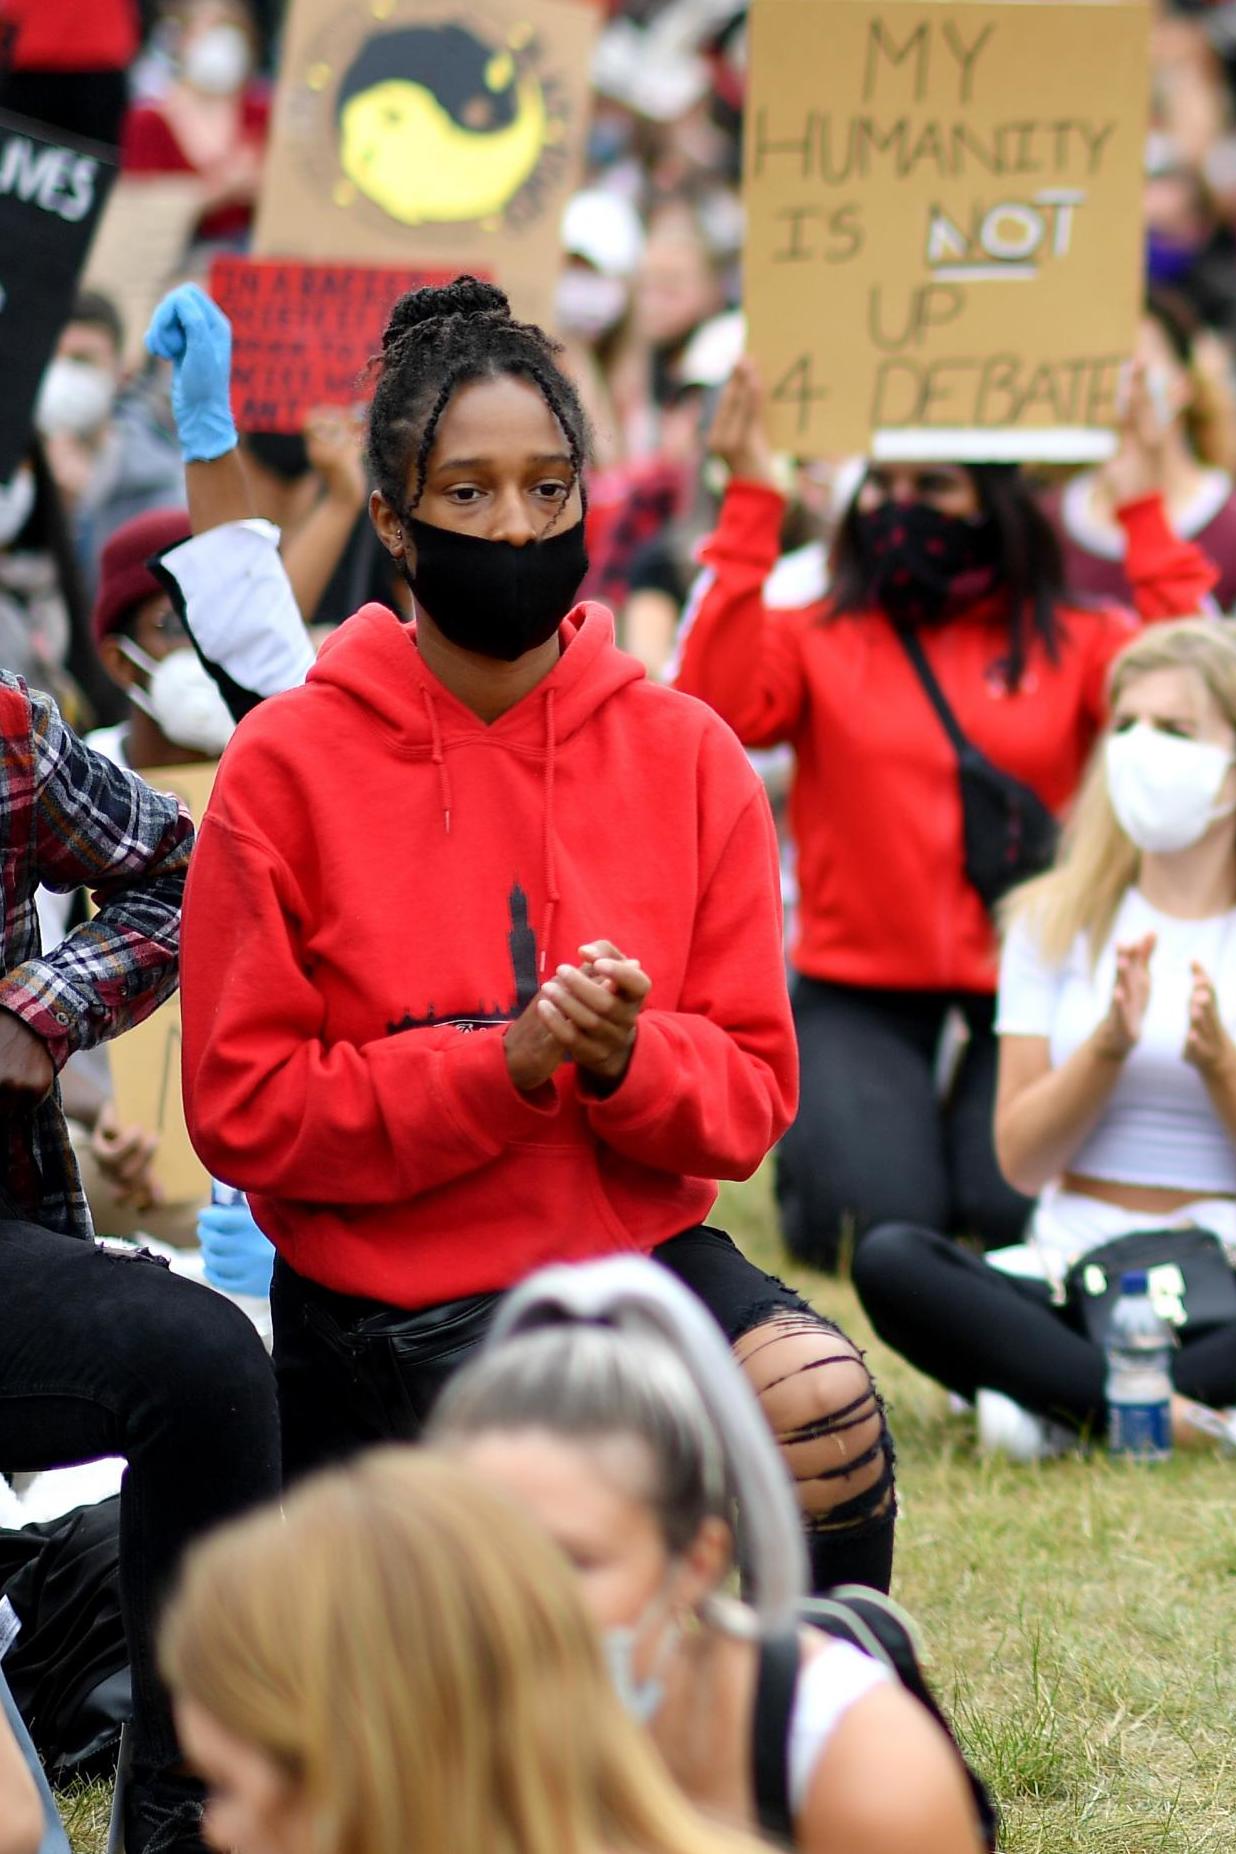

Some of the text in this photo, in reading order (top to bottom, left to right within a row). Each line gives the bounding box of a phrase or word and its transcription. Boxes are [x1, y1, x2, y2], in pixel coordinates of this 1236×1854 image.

[861, 14, 997, 107] MY
[0, 138, 98, 221] IVES
[754, 106, 1117, 188] HUMANITY
[772, 187, 1085, 264] IS NOT
[867, 282, 966, 352] UP
[770, 350, 1131, 436] 4 DEBATE
